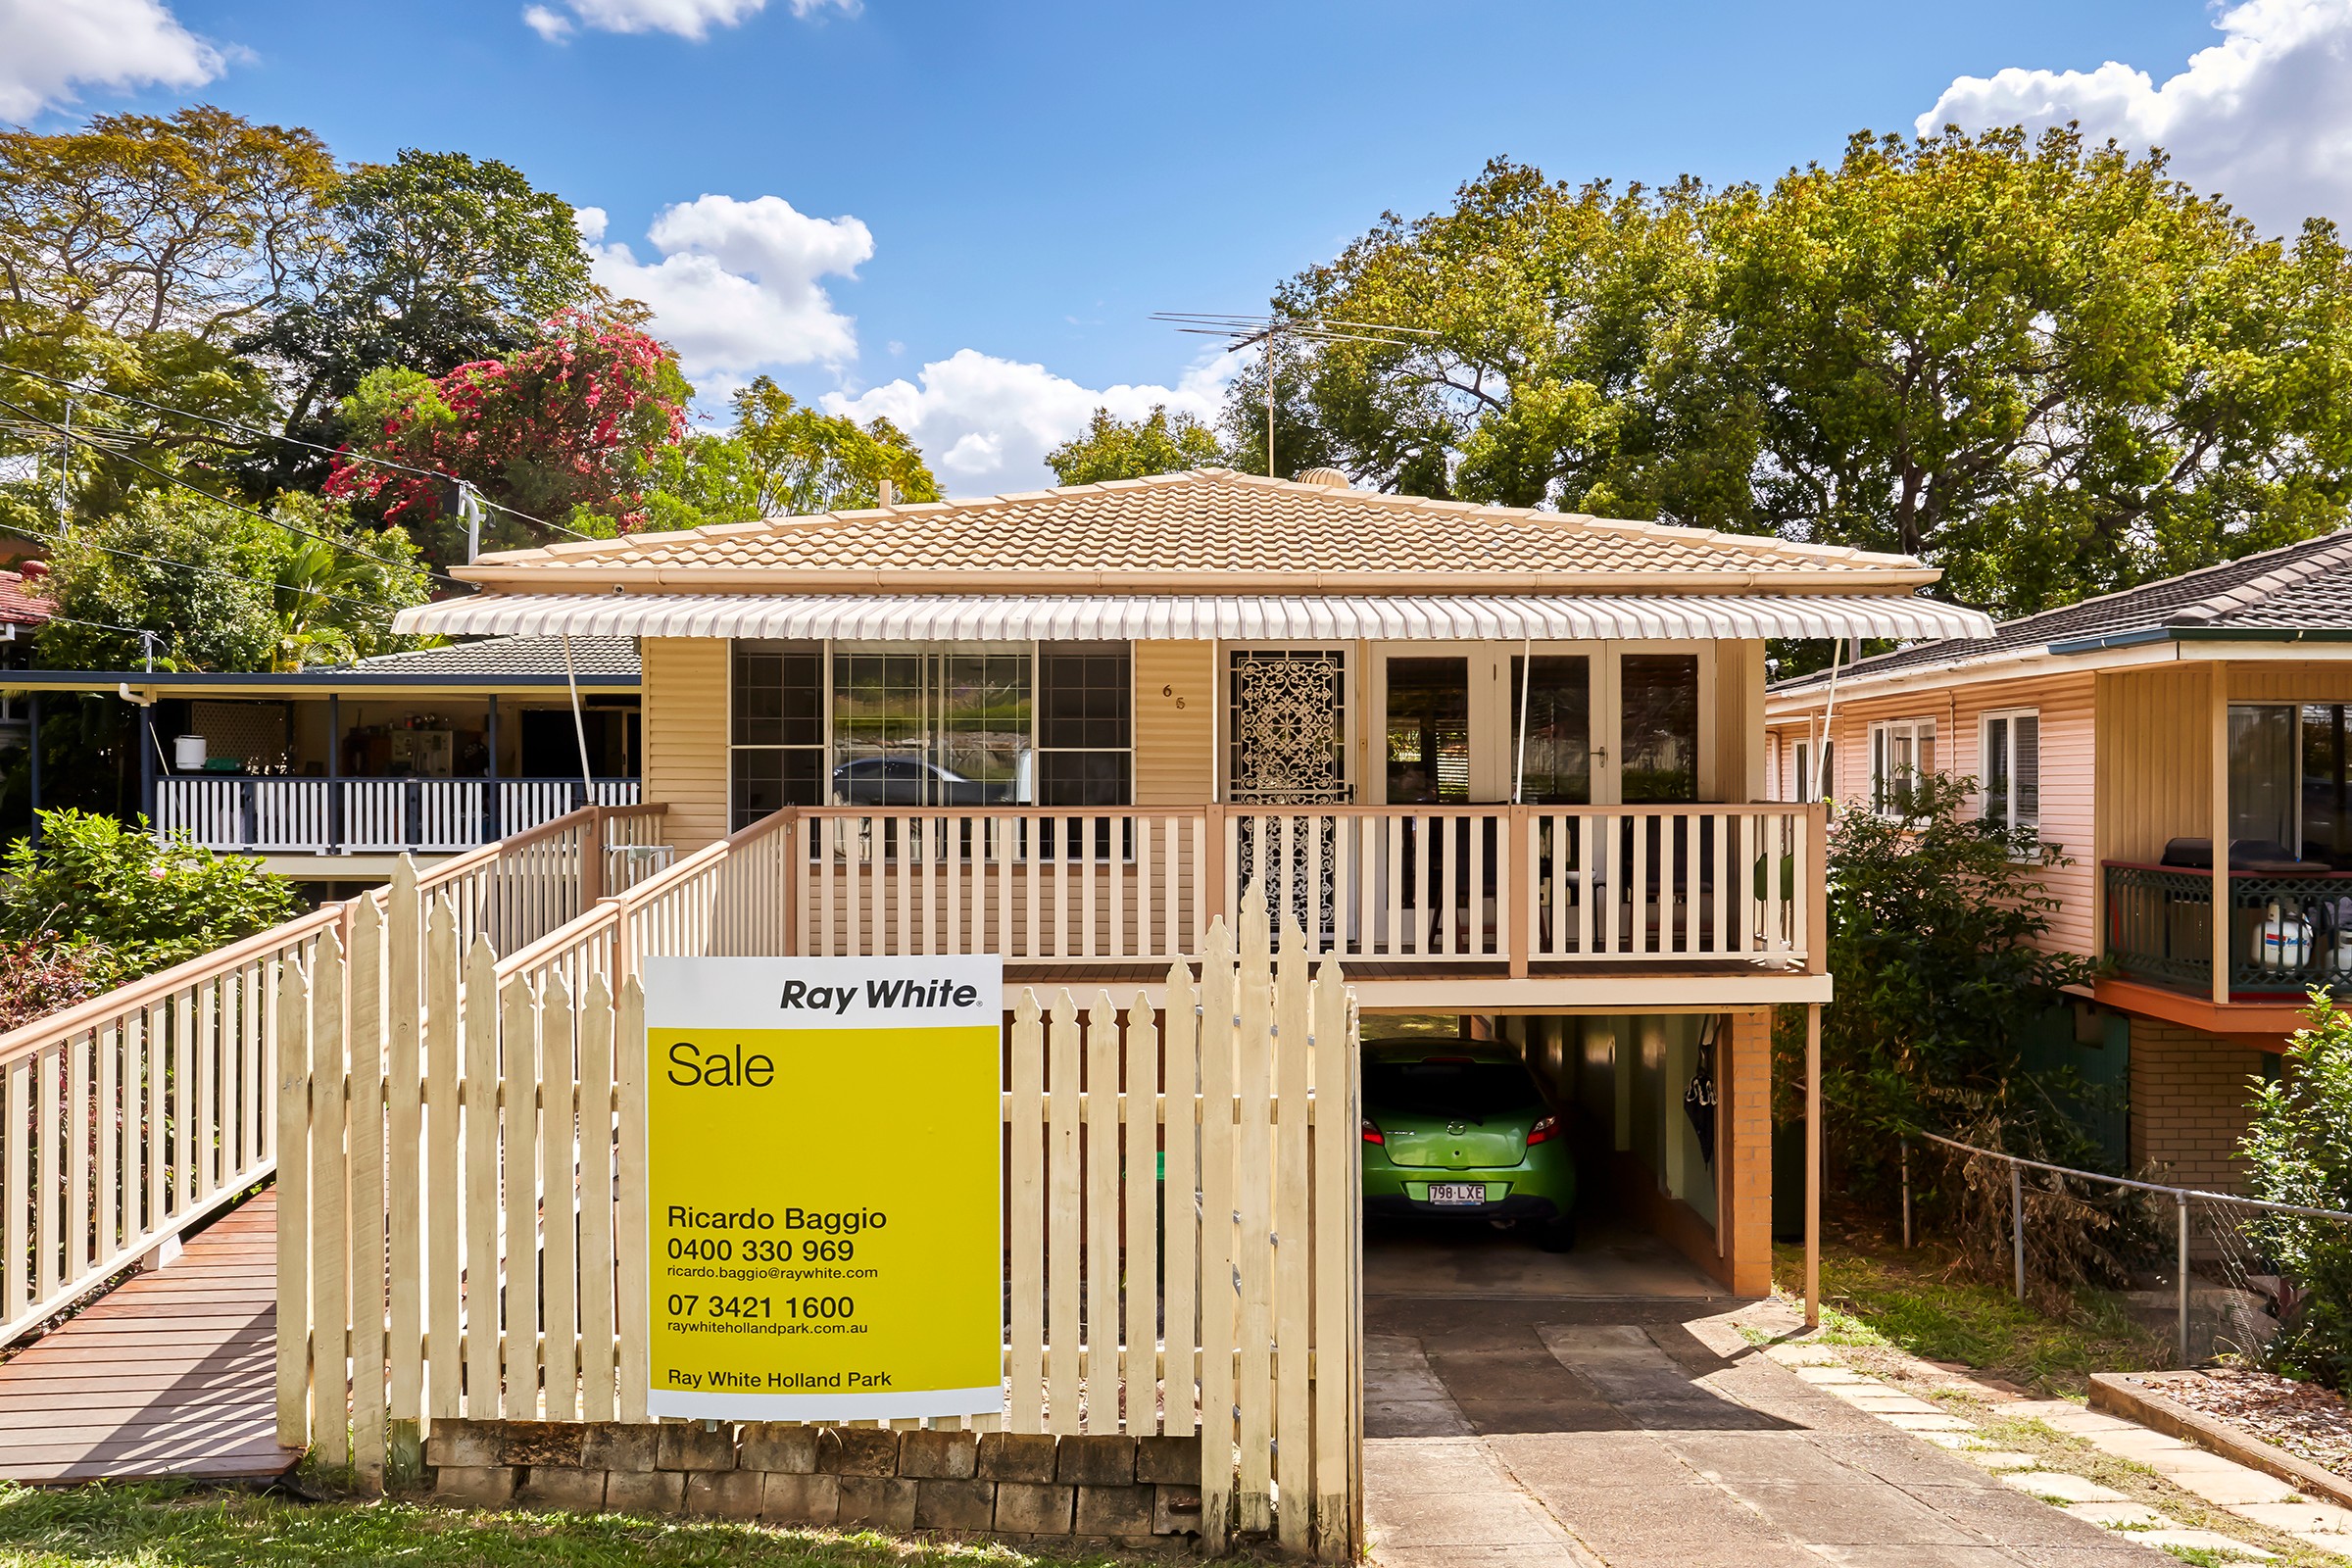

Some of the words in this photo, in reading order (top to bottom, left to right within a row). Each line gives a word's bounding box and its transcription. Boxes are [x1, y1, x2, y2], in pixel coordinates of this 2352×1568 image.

[780, 980, 858, 1015] Ray
[866, 978, 977, 1009] White
[667, 1042, 774, 1088] Sale
[667, 1205, 774, 1230] Ricardo
[785, 1206, 887, 1235] Baggio
[667, 1238, 732, 1261] 0400
[742, 1239, 793, 1262] 330
[803, 1240, 854, 1262] 969
[667, 1264, 878, 1281] ricardo.baggio@raywhite.com
[667, 1294, 699, 1317] 07
[709, 1296, 770, 1318] 3421
[786, 1296, 855, 1319] 1600
[667, 1320, 868, 1335] raywhitehollandpark.com.au
[667, 1369, 703, 1389] Ray
[708, 1371, 761, 1388] White
[767, 1372, 841, 1388] Holland
[848, 1371, 892, 1387] Park
